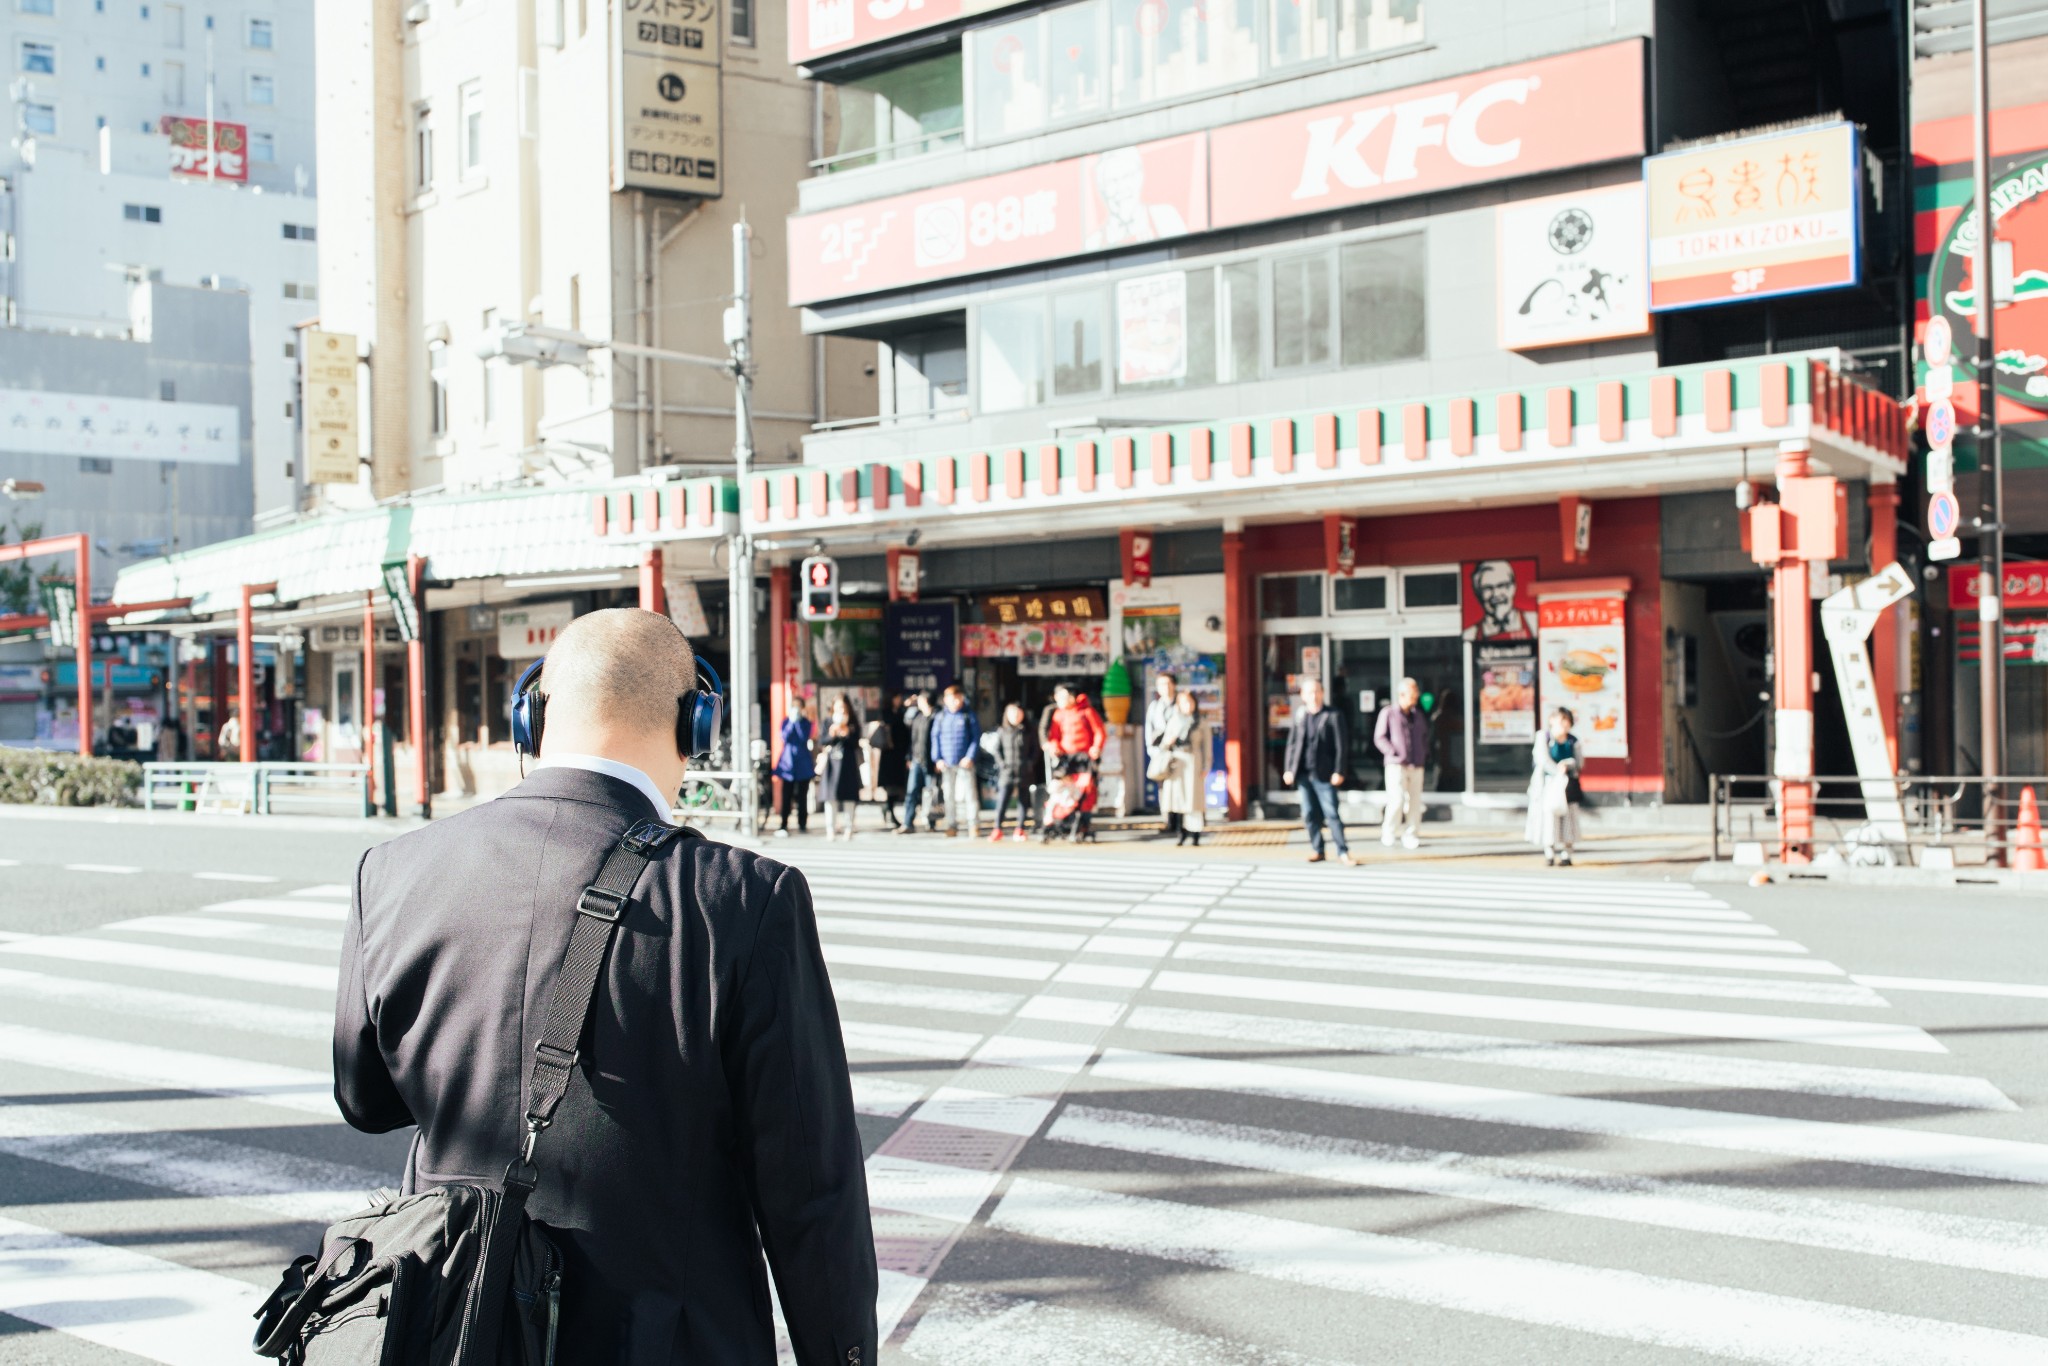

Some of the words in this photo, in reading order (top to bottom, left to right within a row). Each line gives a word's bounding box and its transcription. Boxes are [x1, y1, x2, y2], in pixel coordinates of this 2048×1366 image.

[1291, 78, 1529, 200] KFC
[820, 217, 865, 264] 2F
[1676, 219, 1824, 257] TORIKIZOKU
[1731, 266, 1766, 294] 3F
